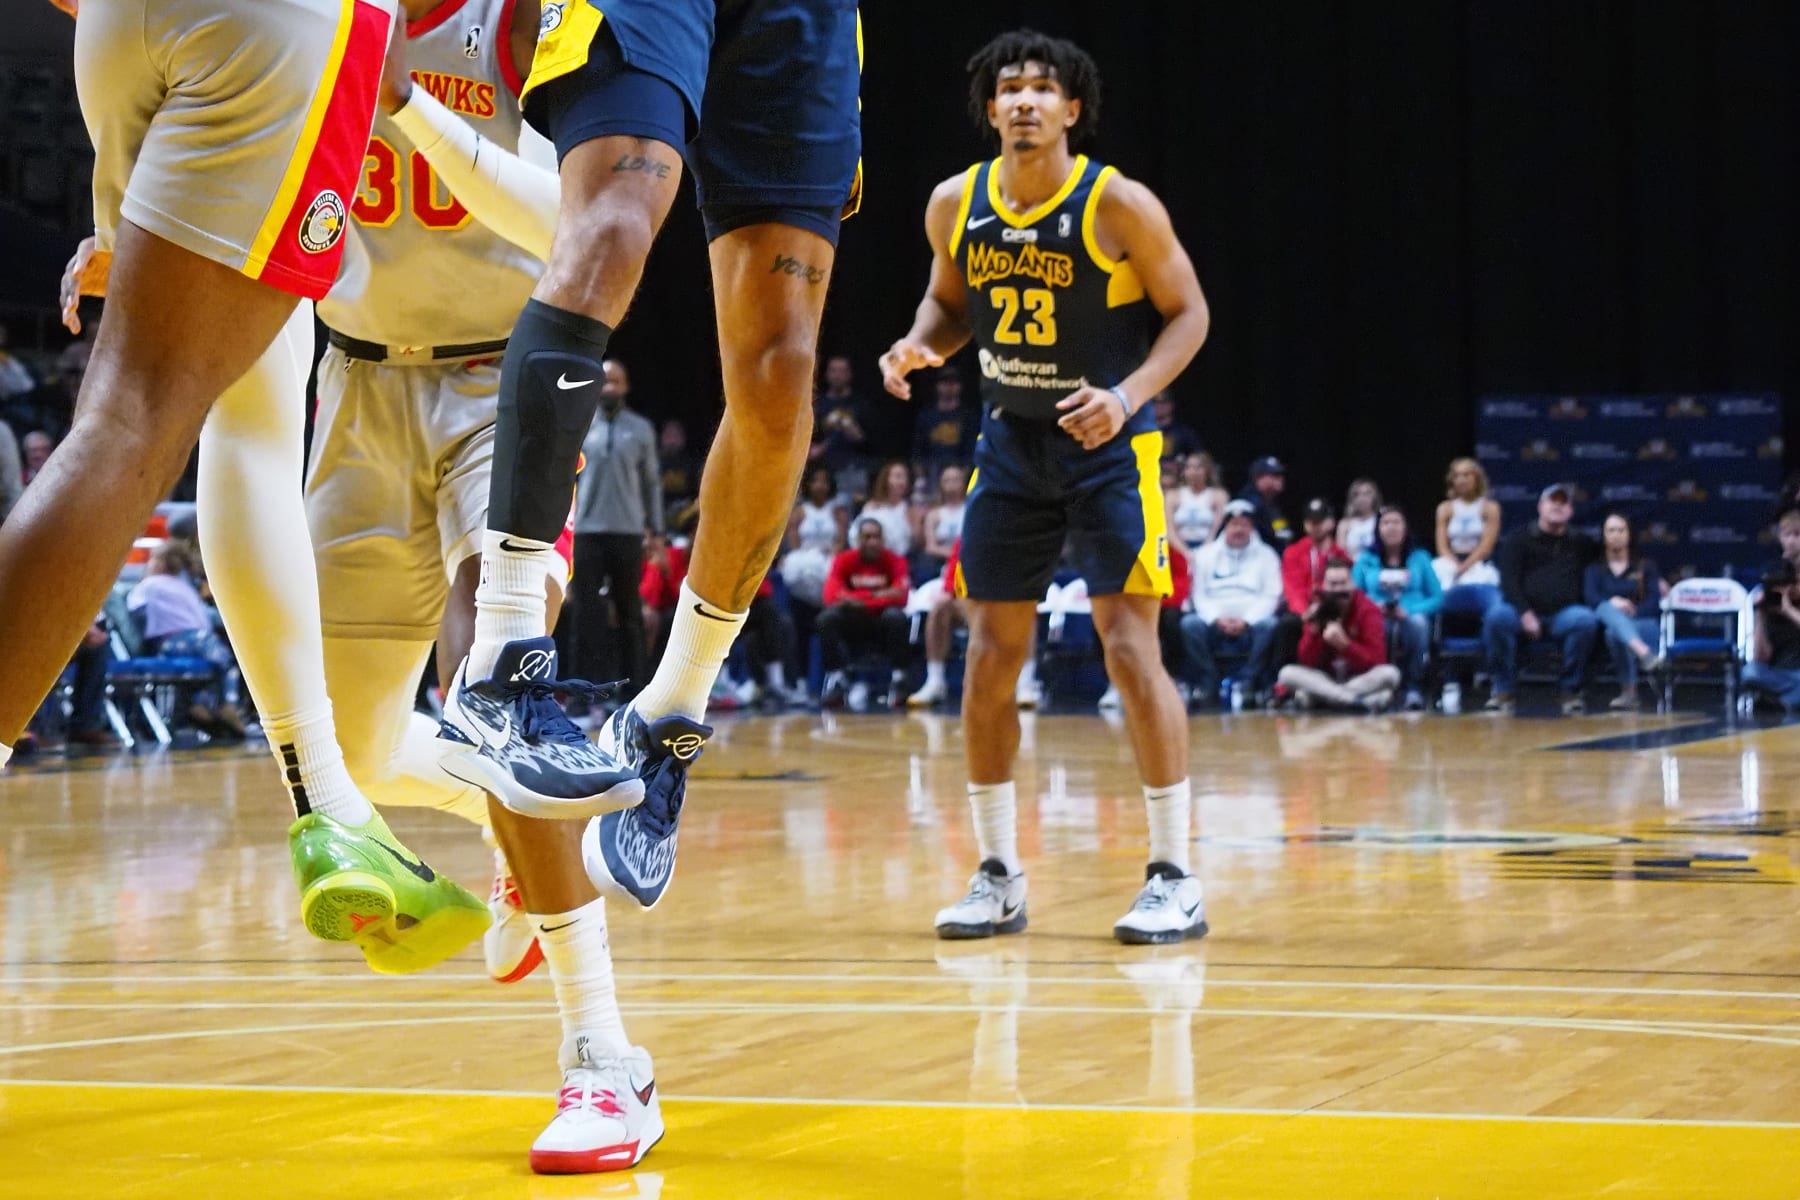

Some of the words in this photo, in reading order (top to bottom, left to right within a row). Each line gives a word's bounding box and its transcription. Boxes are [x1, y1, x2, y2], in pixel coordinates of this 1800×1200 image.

[967, 241, 1014, 290] MAD
[1014, 241, 1073, 288] ANTS
[991, 287, 1057, 346] 23
